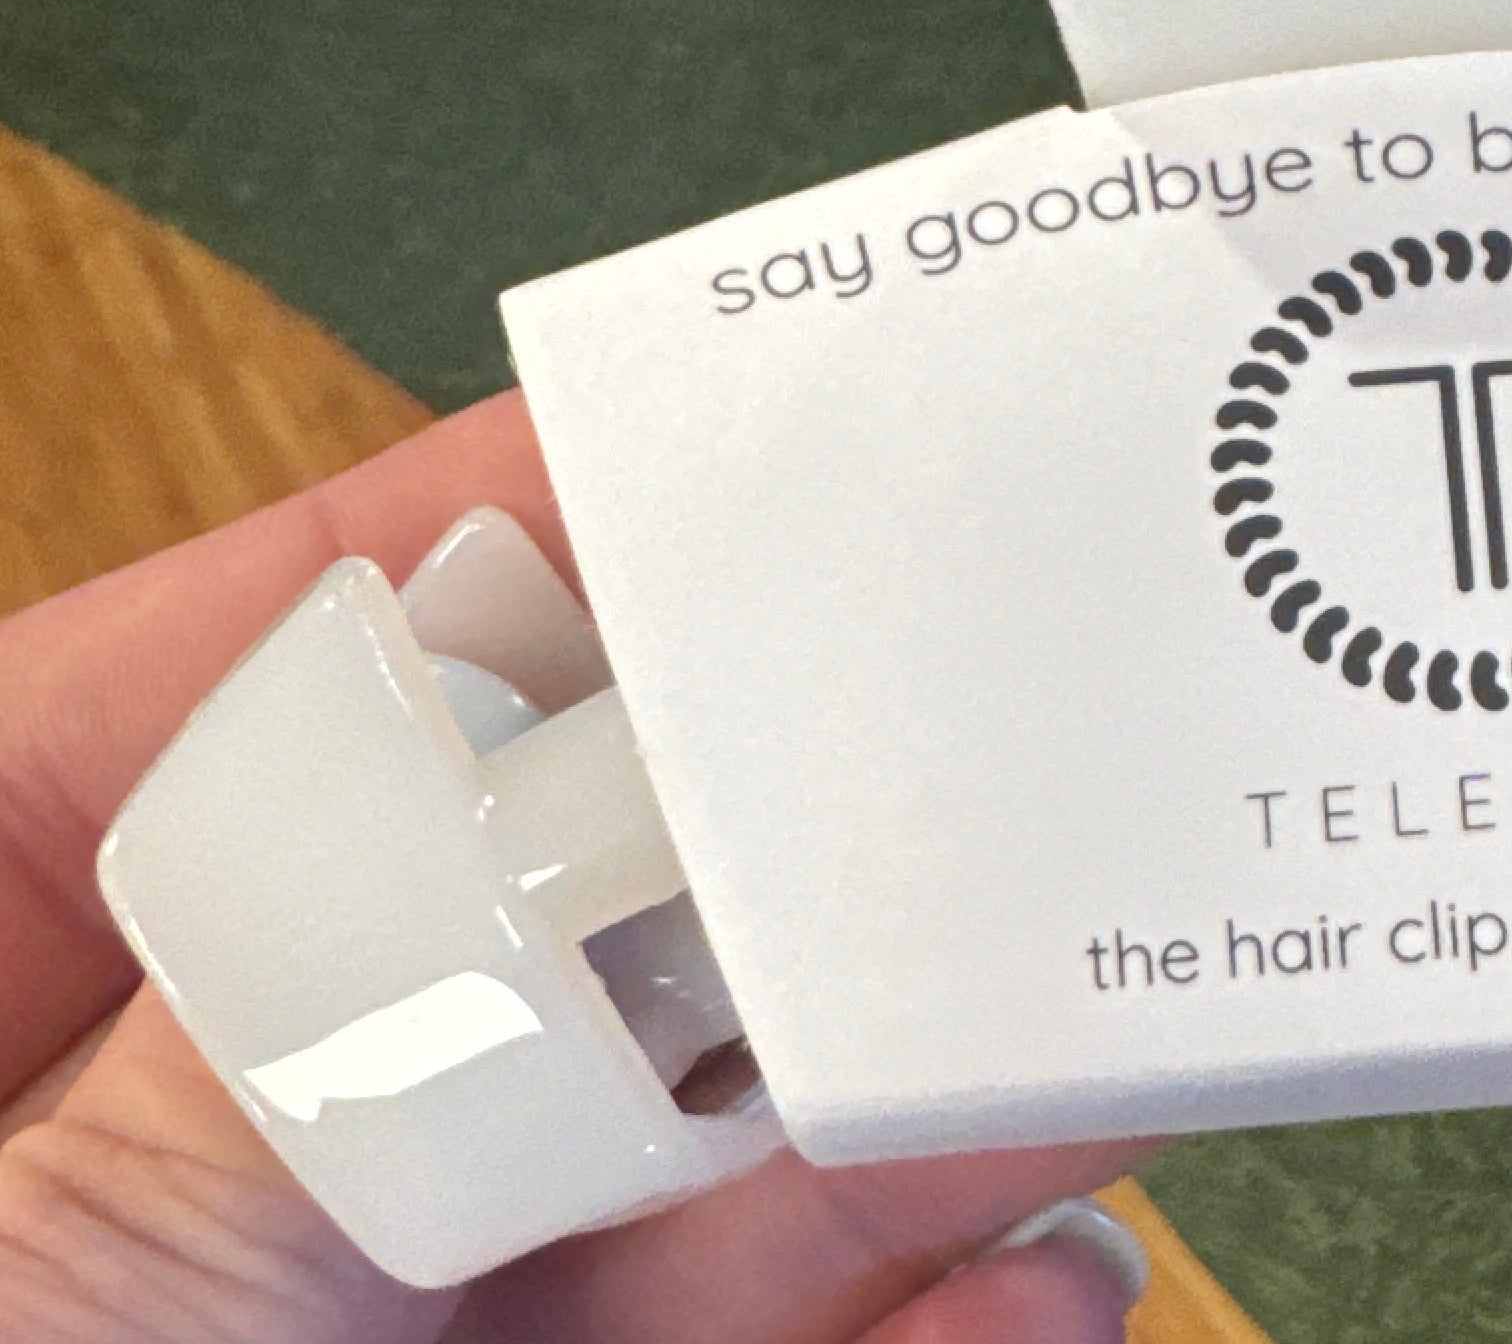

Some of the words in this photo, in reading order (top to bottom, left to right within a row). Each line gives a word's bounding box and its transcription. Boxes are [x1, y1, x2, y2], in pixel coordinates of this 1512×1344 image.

[710, 232, 874, 316] say
[904, 146, 1314, 278] goodbye
[1341, 127, 1436, 185] to
[1084, 926, 1200, 992] the
[1224, 914, 1364, 980] hair
